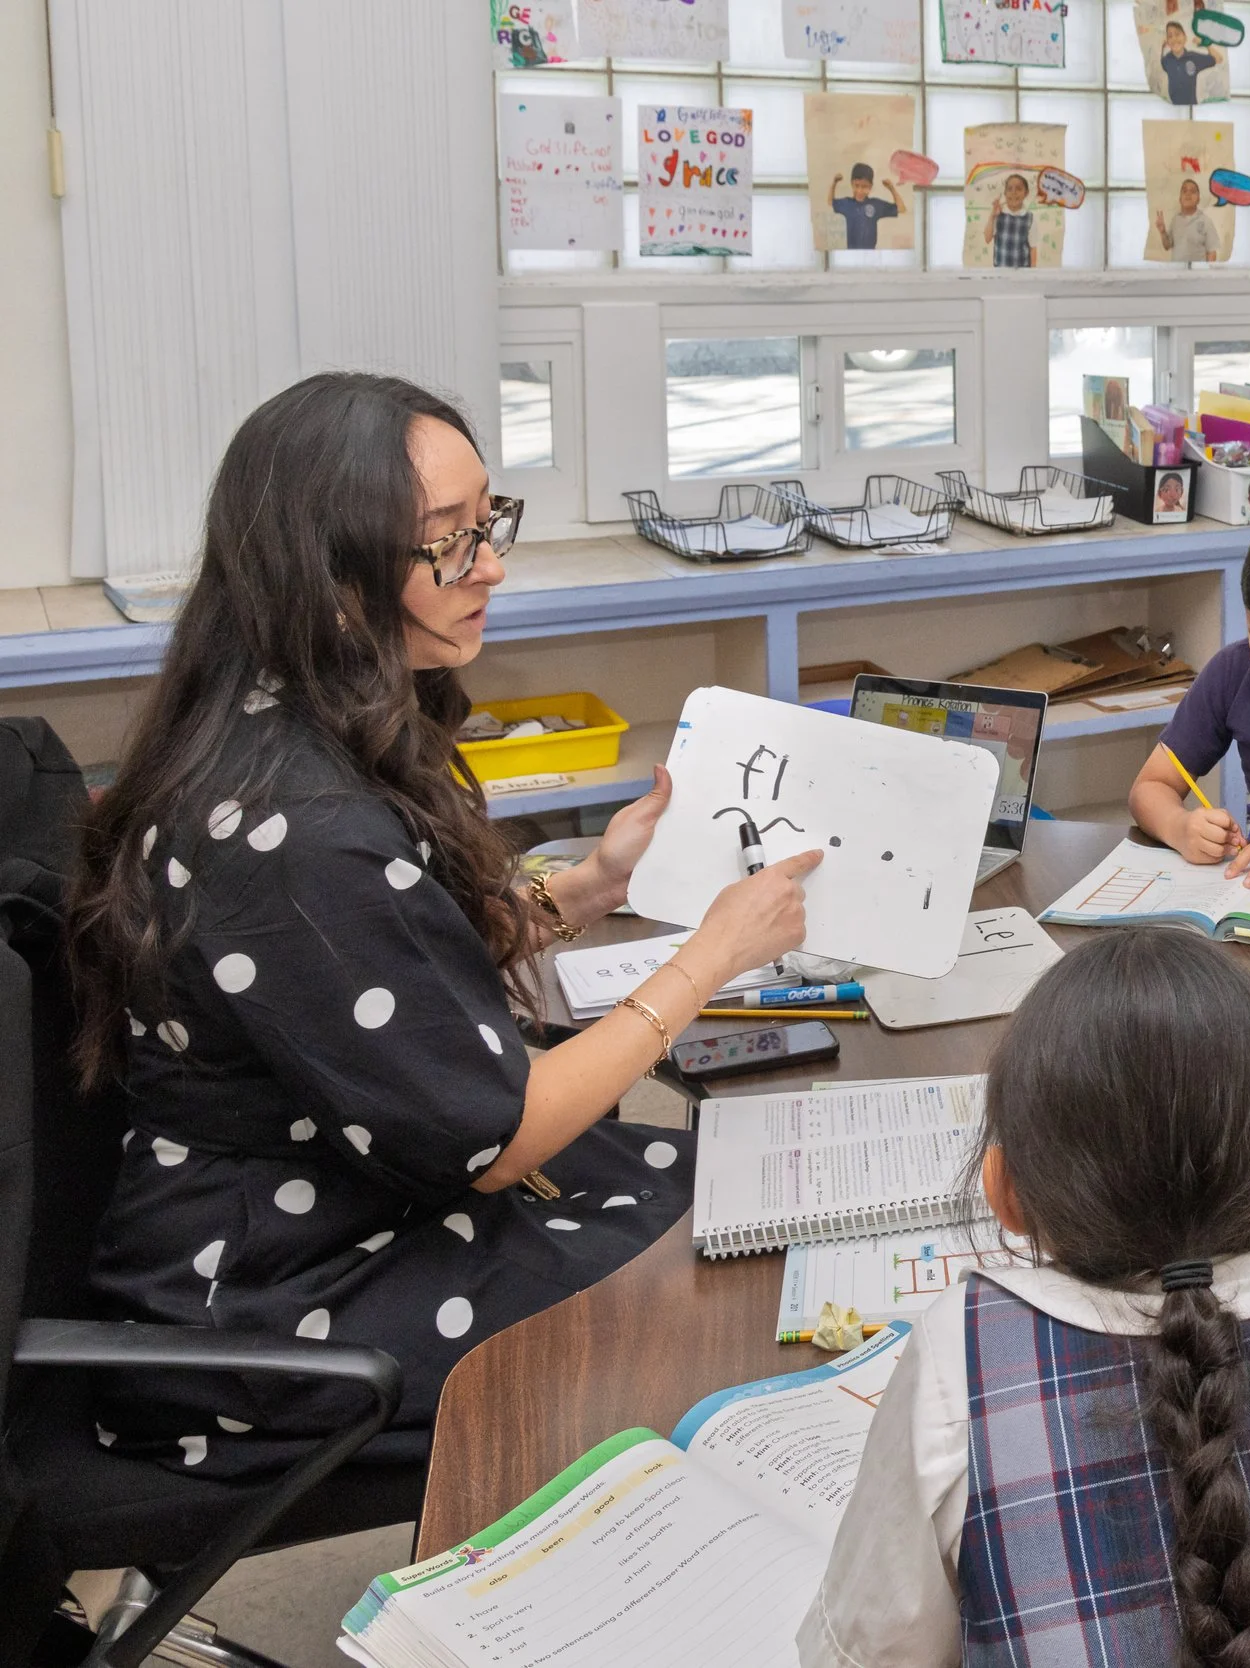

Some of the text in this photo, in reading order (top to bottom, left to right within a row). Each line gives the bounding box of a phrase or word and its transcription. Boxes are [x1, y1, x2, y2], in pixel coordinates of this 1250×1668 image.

[643, 127, 745, 147] LOVE GOD
[788, 985, 824, 1001] EXPO
[837, 1332, 895, 1368] Phonics and Spelling
[702, 1427, 720, 1446] Read
[720, 1414, 735, 1428] each
[726, 1427, 744, 1442] Hint:
[754, 1443, 772, 1459] Hint:
[768, 1443, 798, 1467] opposite
[775, 1456, 793, 1471] Hint:
[793, 1458, 823, 1482] opposite
[800, 1471, 819, 1487] Hint:
[826, 1486, 845, 1502] Hint:
[489, 1462, 664, 1586] also been good look
[423, 1586, 446, 1599] Build
[454, 1572, 475, 1586] story
[475, 1566, 487, 1577] by
[487, 1549, 515, 1567] writing
[515, 1540, 529, 1552] the
[530, 1519, 559, 1541] missing
[558, 1502, 581, 1521] Super
[580, 1481, 607, 1501] Words.
[476, 1603, 499, 1617] have
[592, 1526, 617, 1546] trying
[616, 1518, 625, 1527] to
[625, 1502, 645, 1520] keep
[644, 1488, 664, 1503] Spot
[664, 1475, 688, 1490] clean.
[401, 1558, 454, 1582] Super Words
[482, 1618, 504, 1632] Spot
[513, 1602, 533, 1616] very
[634, 1510, 663, 1534] finding
[662, 1495, 682, 1511] mud.
[495, 1631, 513, 1643] But
[513, 1625, 525, 1635] he
[618, 1550, 638, 1567] likes
[638, 1539, 650, 1551] his
[650, 1521, 675, 1541] baths.
[535, 1653, 552, 1664] two
[552, 1630, 593, 1656] sentences
[593, 1615, 616, 1632] using
[623, 1586, 656, 1612] different
[655, 1567, 679, 1587] Super
[678, 1550, 700, 1568] Word
[708, 1529, 727, 1545] each
[727, 1512, 760, 1531] sentence.
[509, 1641, 527, 1654] Just
[624, 1575, 634, 1584] at
[633, 1560, 652, 1577] him!
